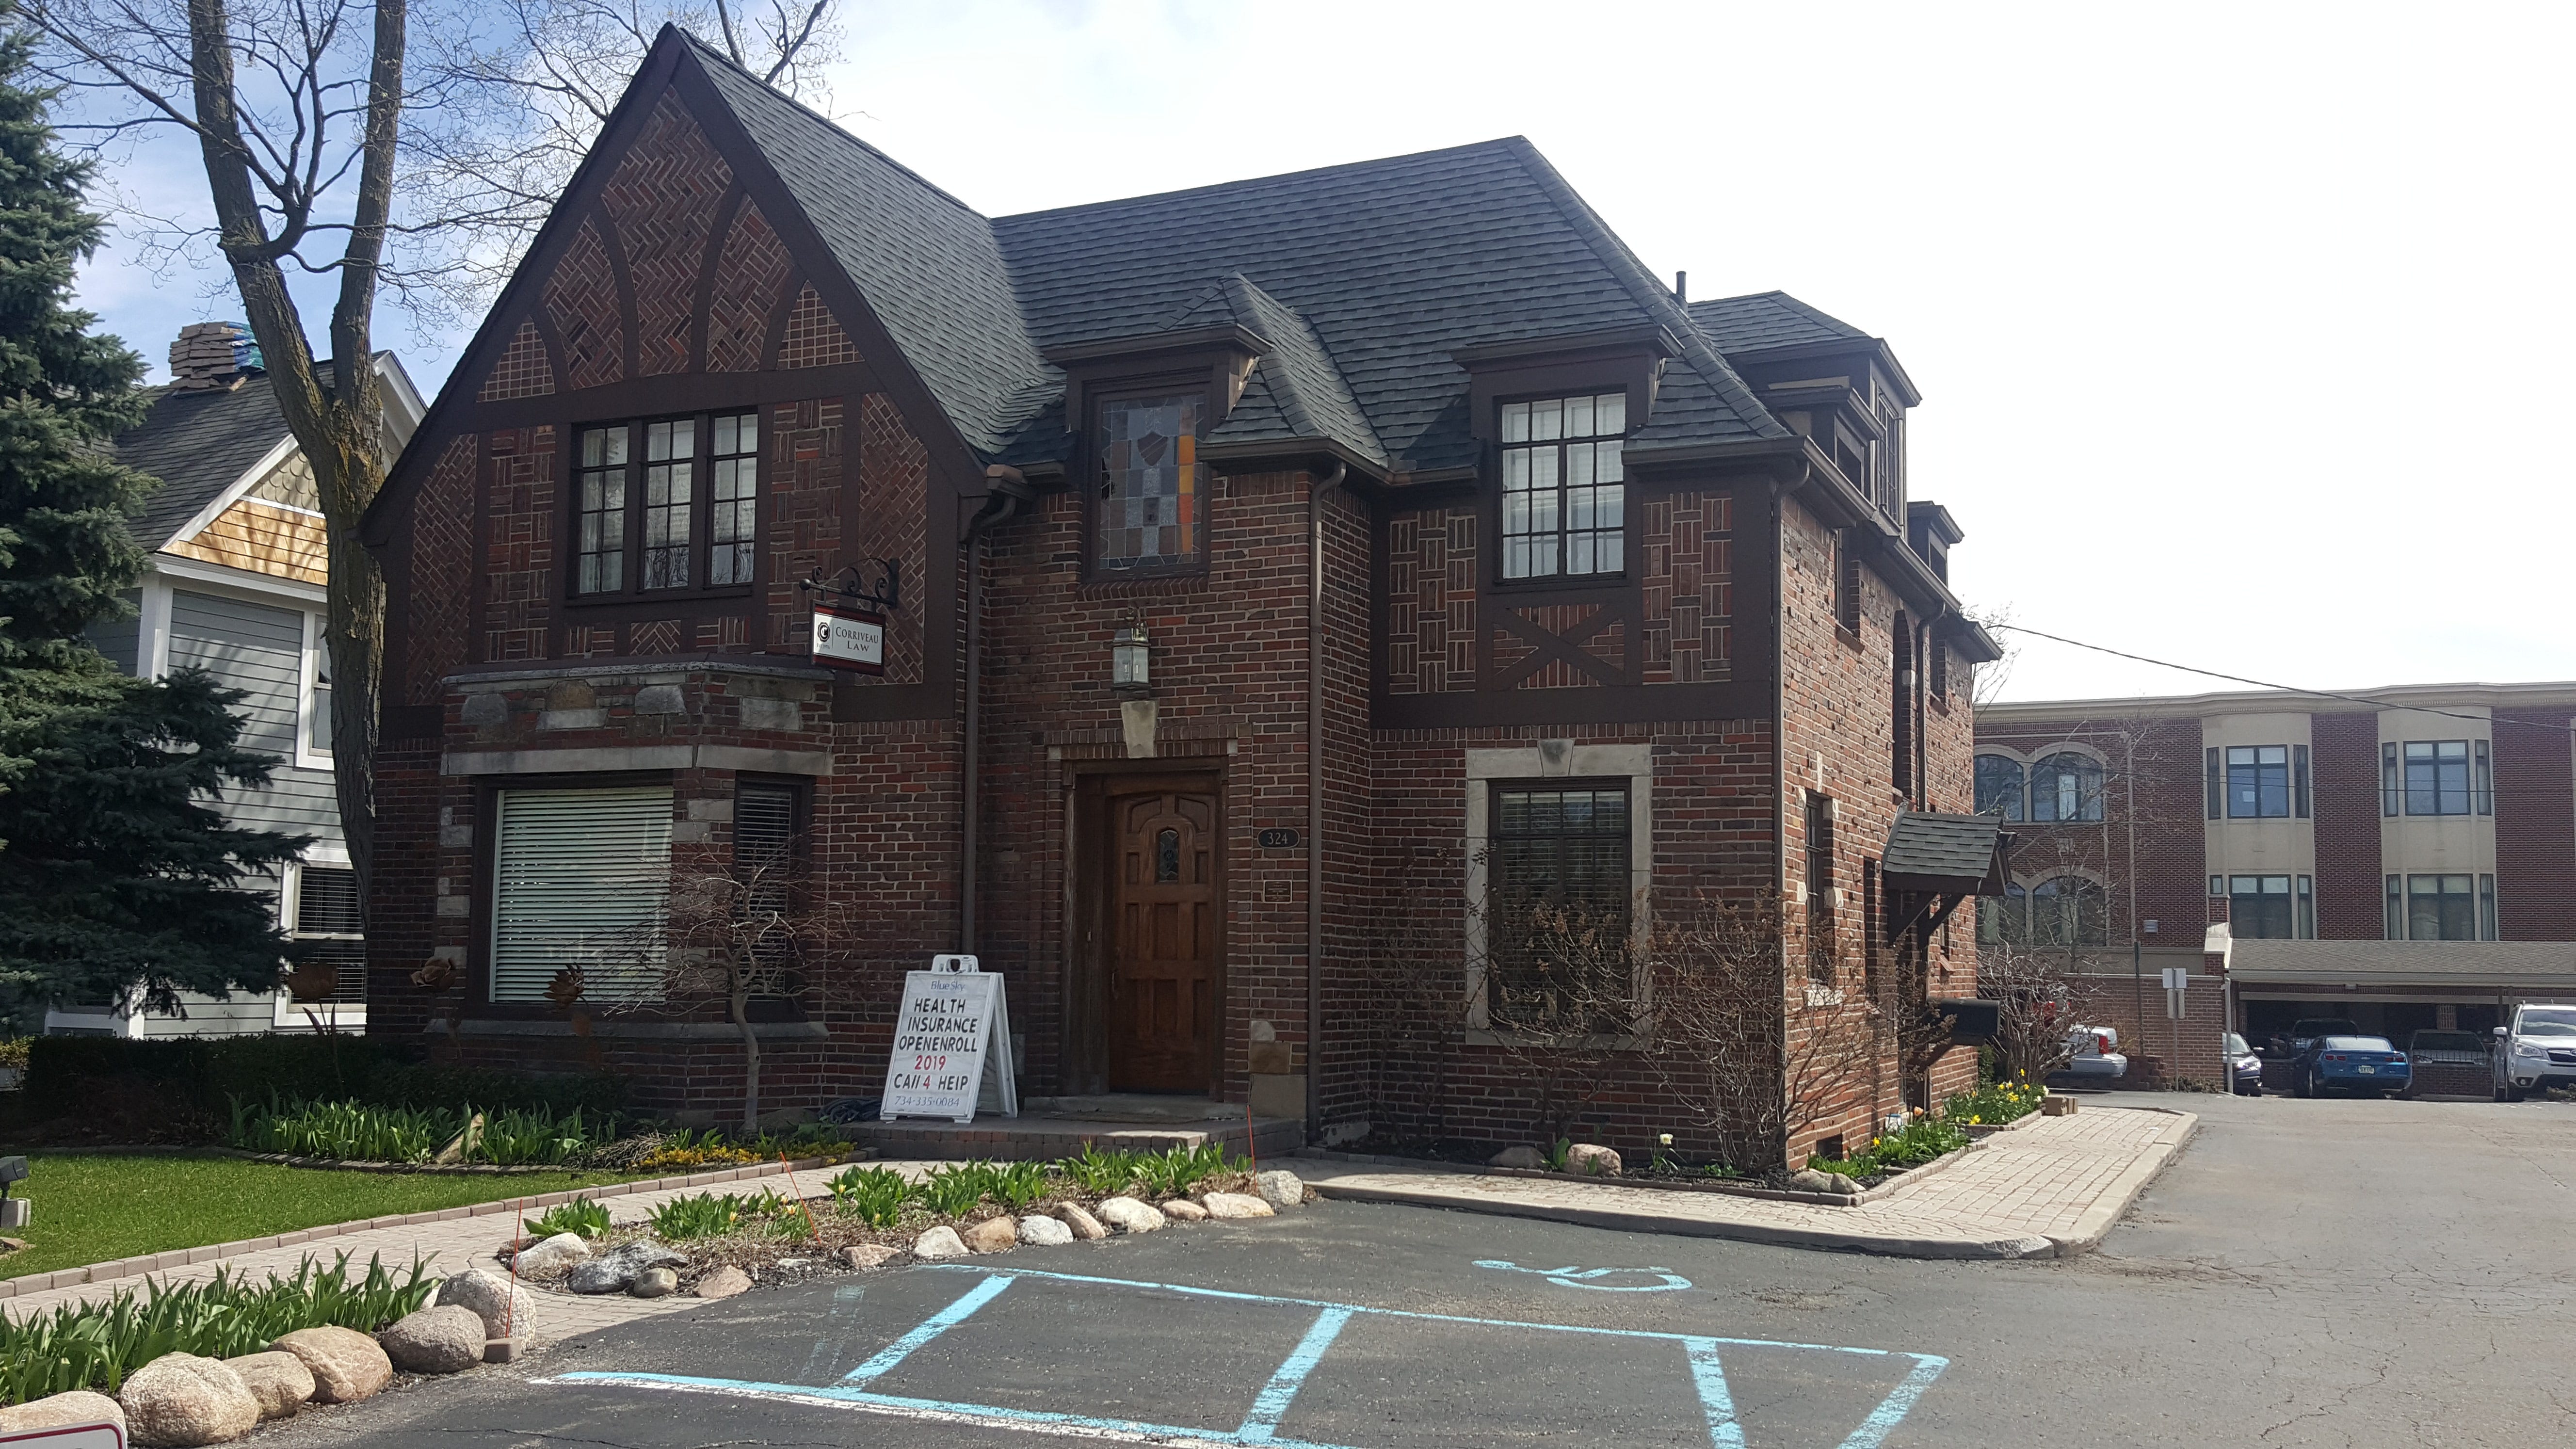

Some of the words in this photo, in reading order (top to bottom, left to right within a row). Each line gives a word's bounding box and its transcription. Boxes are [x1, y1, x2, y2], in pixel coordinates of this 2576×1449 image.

[836, 627, 879, 644] CORRIVEAU
[847, 641, 869, 652] LAW
[1268, 832, 1288, 845] 324
[914, 998, 966, 1014] HEALTH
[907, 1016, 978, 1033] INSURANCE
[914, 1055, 947, 1071] 2019
[923, 1075, 930, 1089] 4
